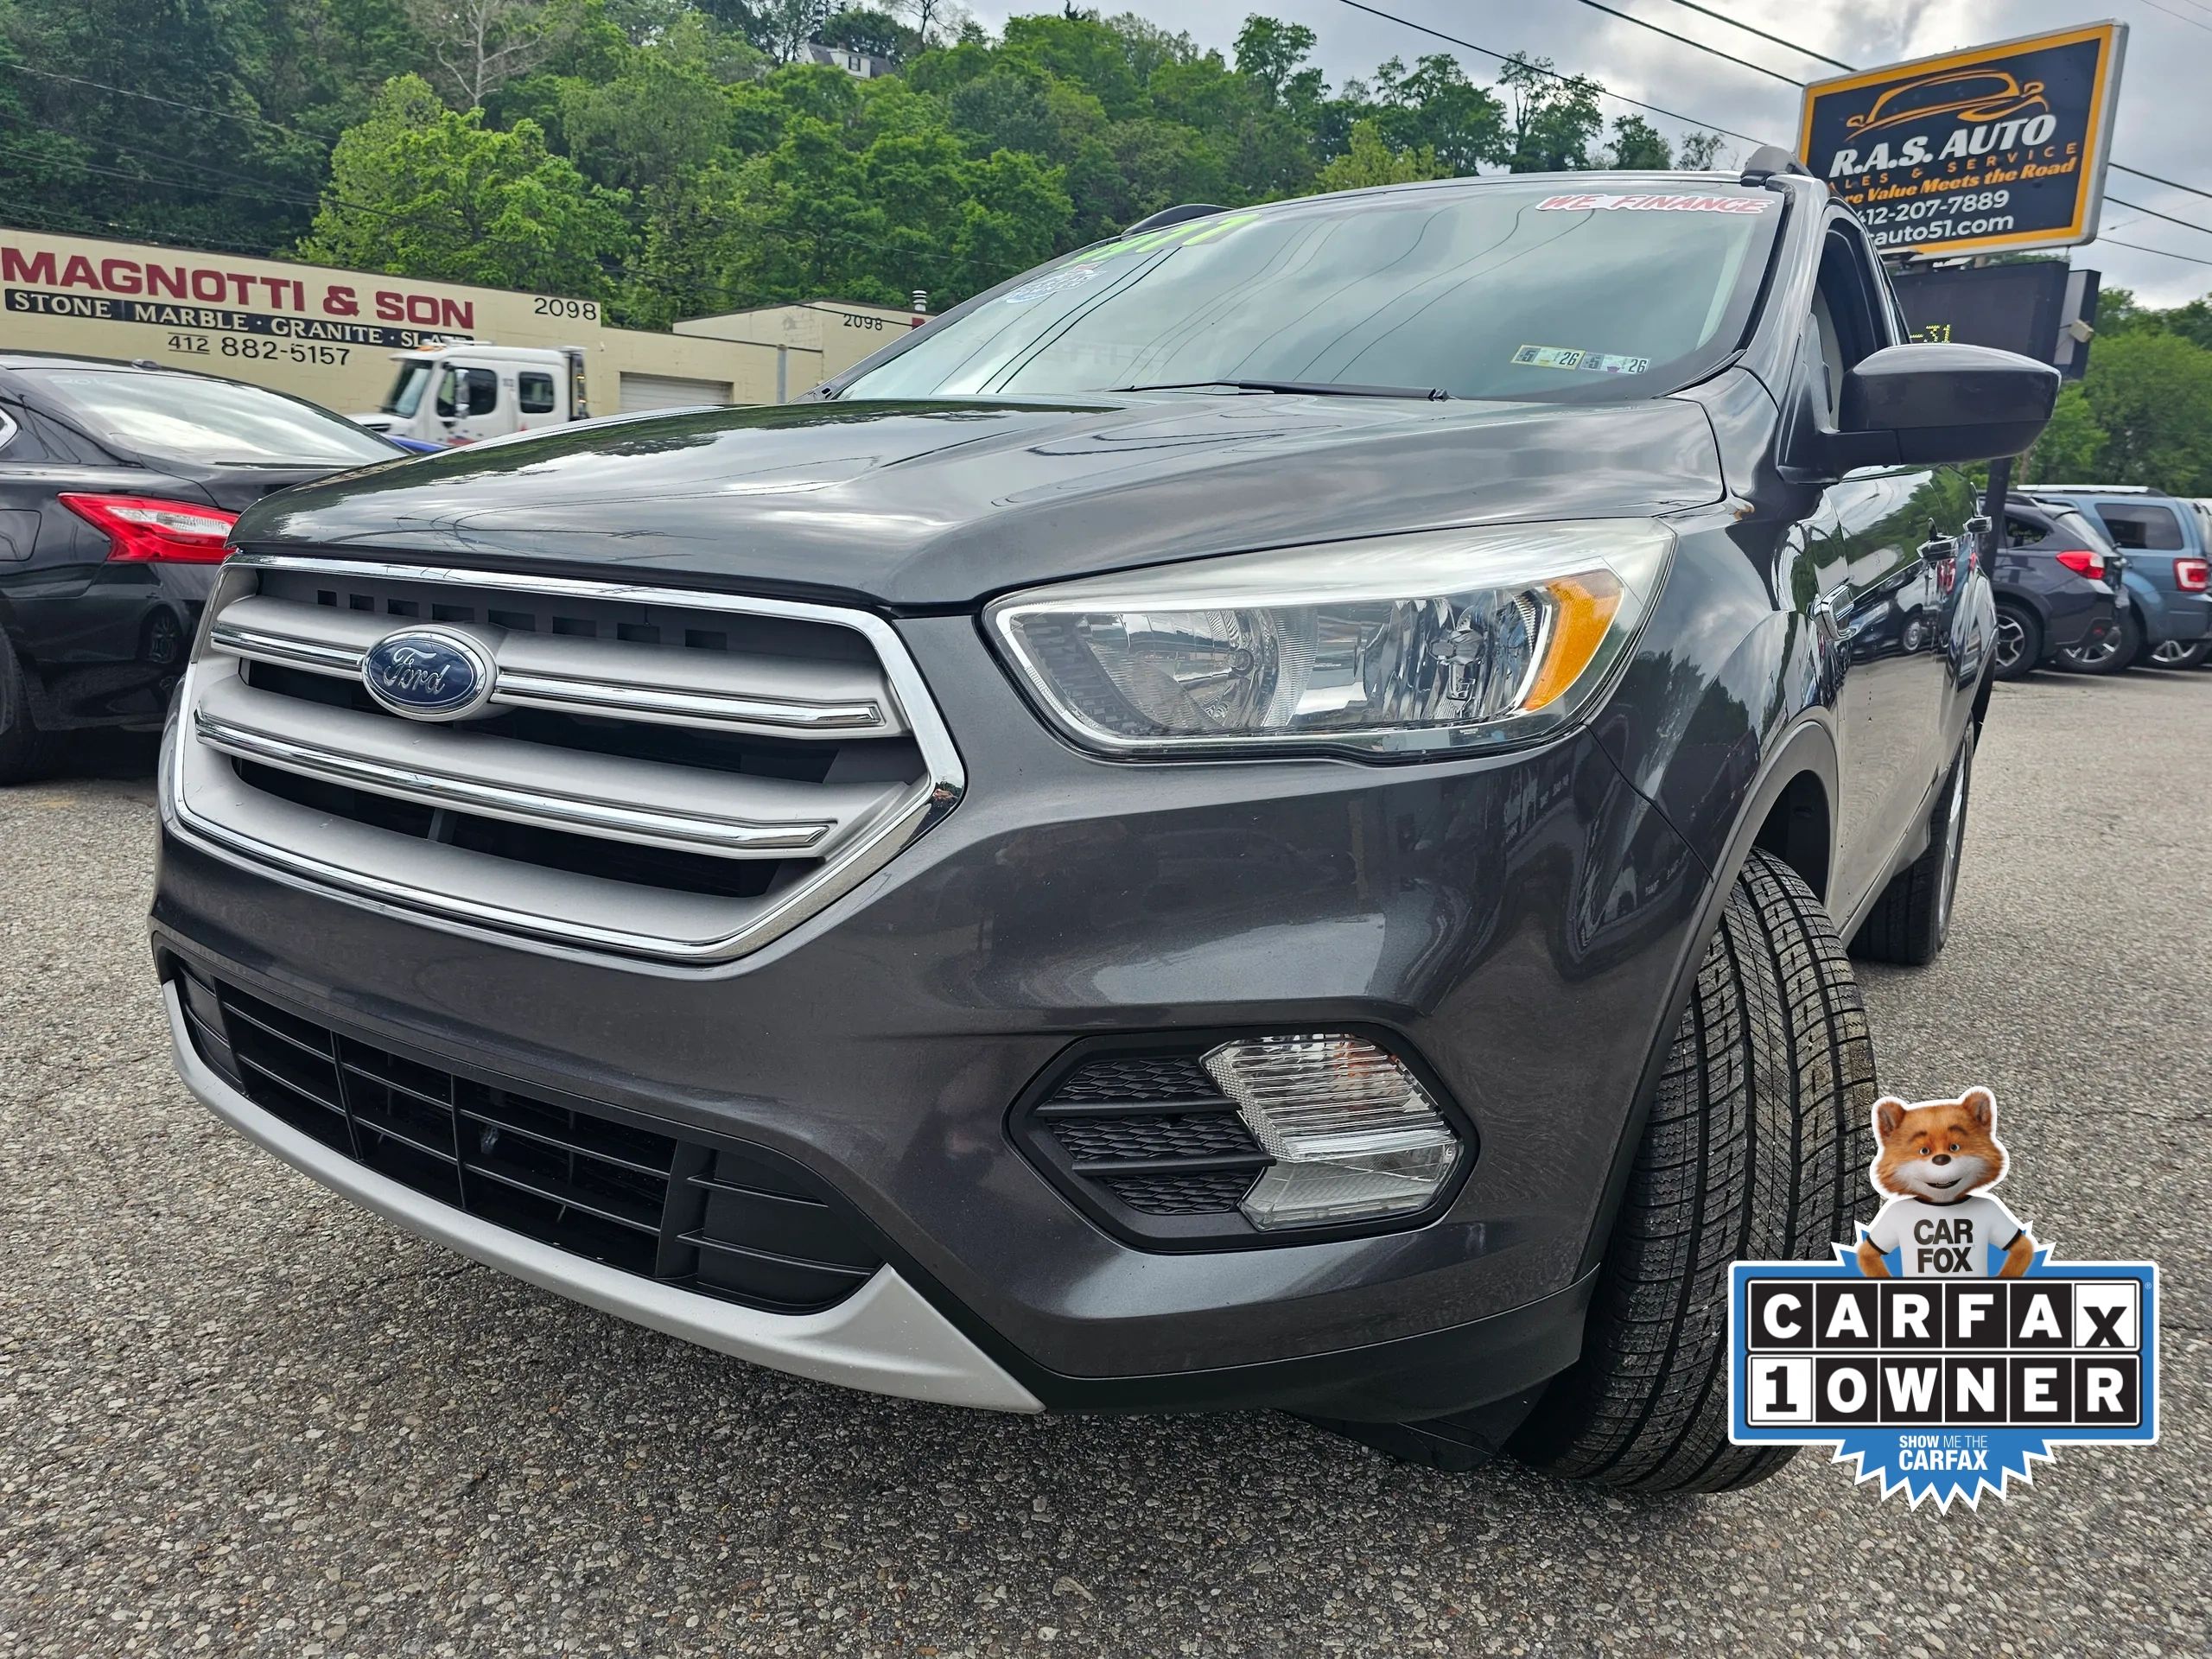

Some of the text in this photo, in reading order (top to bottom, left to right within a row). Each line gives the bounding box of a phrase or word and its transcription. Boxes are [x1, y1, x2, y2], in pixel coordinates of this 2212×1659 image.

[1828, 114, 2056, 178] R.A.S. AUTO
[1910, 167, 1923, 179] &
[1947, 142, 2078, 174] SERVICE
[1867, 183, 1918, 203] Value
[1920, 172, 1980, 194] Meets
[1983, 165, 2018, 183] the
[2019, 156, 2078, 180] Road
[1541, 194, 1770, 213] WE FINANCE
[1, 247, 474, 330] MAGNOTTI & SON
[14, 292, 112, 319] STONE
[134, 303, 250, 332] MARBLE
[270, 317, 383, 345] GRANITE
[534, 297, 596, 321] 2098
[843, 314, 883, 332] 2098
[168, 335, 350, 365] 412 882-5157
[1559, 352, 1580, 365] 26
[1628, 359, 1647, 373] 26
[383, 646, 452, 695] Ford
